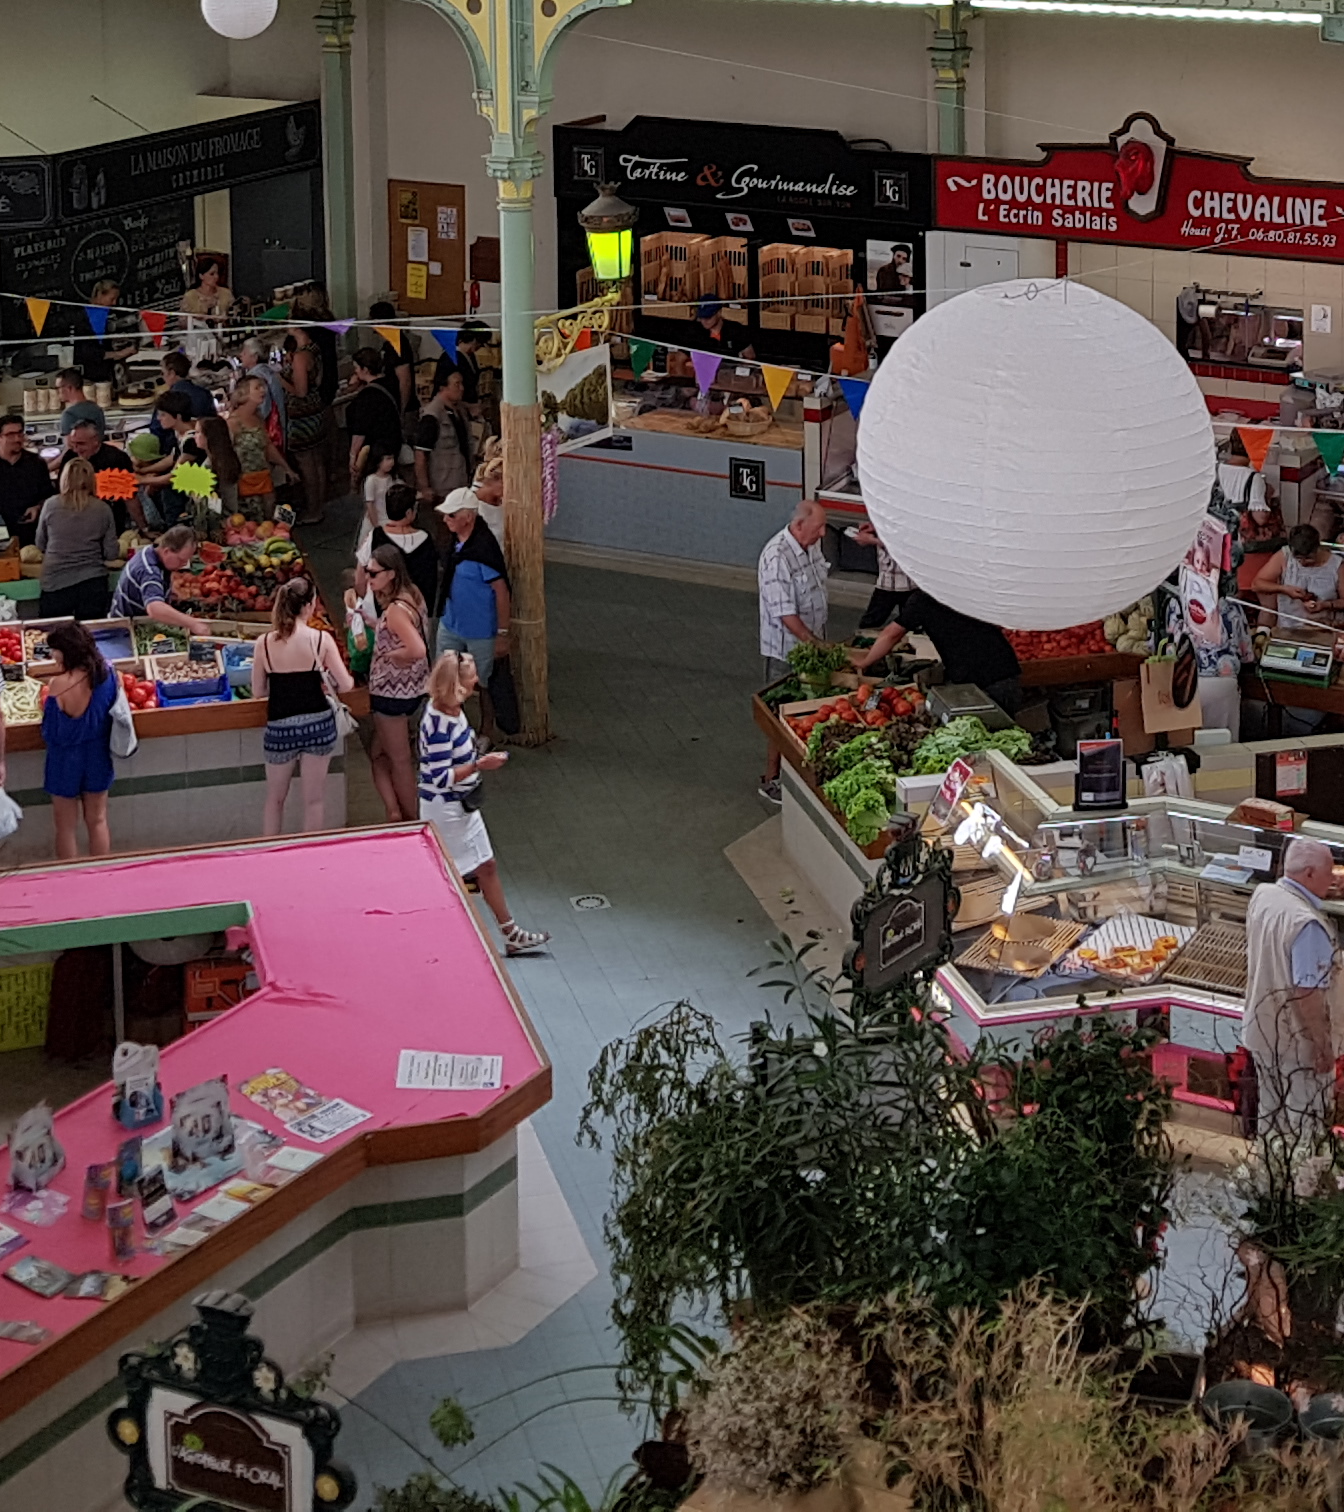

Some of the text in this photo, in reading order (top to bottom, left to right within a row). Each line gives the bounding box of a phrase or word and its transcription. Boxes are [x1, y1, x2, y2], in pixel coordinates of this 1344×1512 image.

[131, 127, 262, 176] LA MAISON DU FROMAGE
[619, 154, 858, 199] Tartine & Gourmandise
[981, 172, 1328, 227] BOUCHERIE CHEVALINE
[1051, 208, 1118, 232] Sablais
[739, 468, 756, 492] TG
